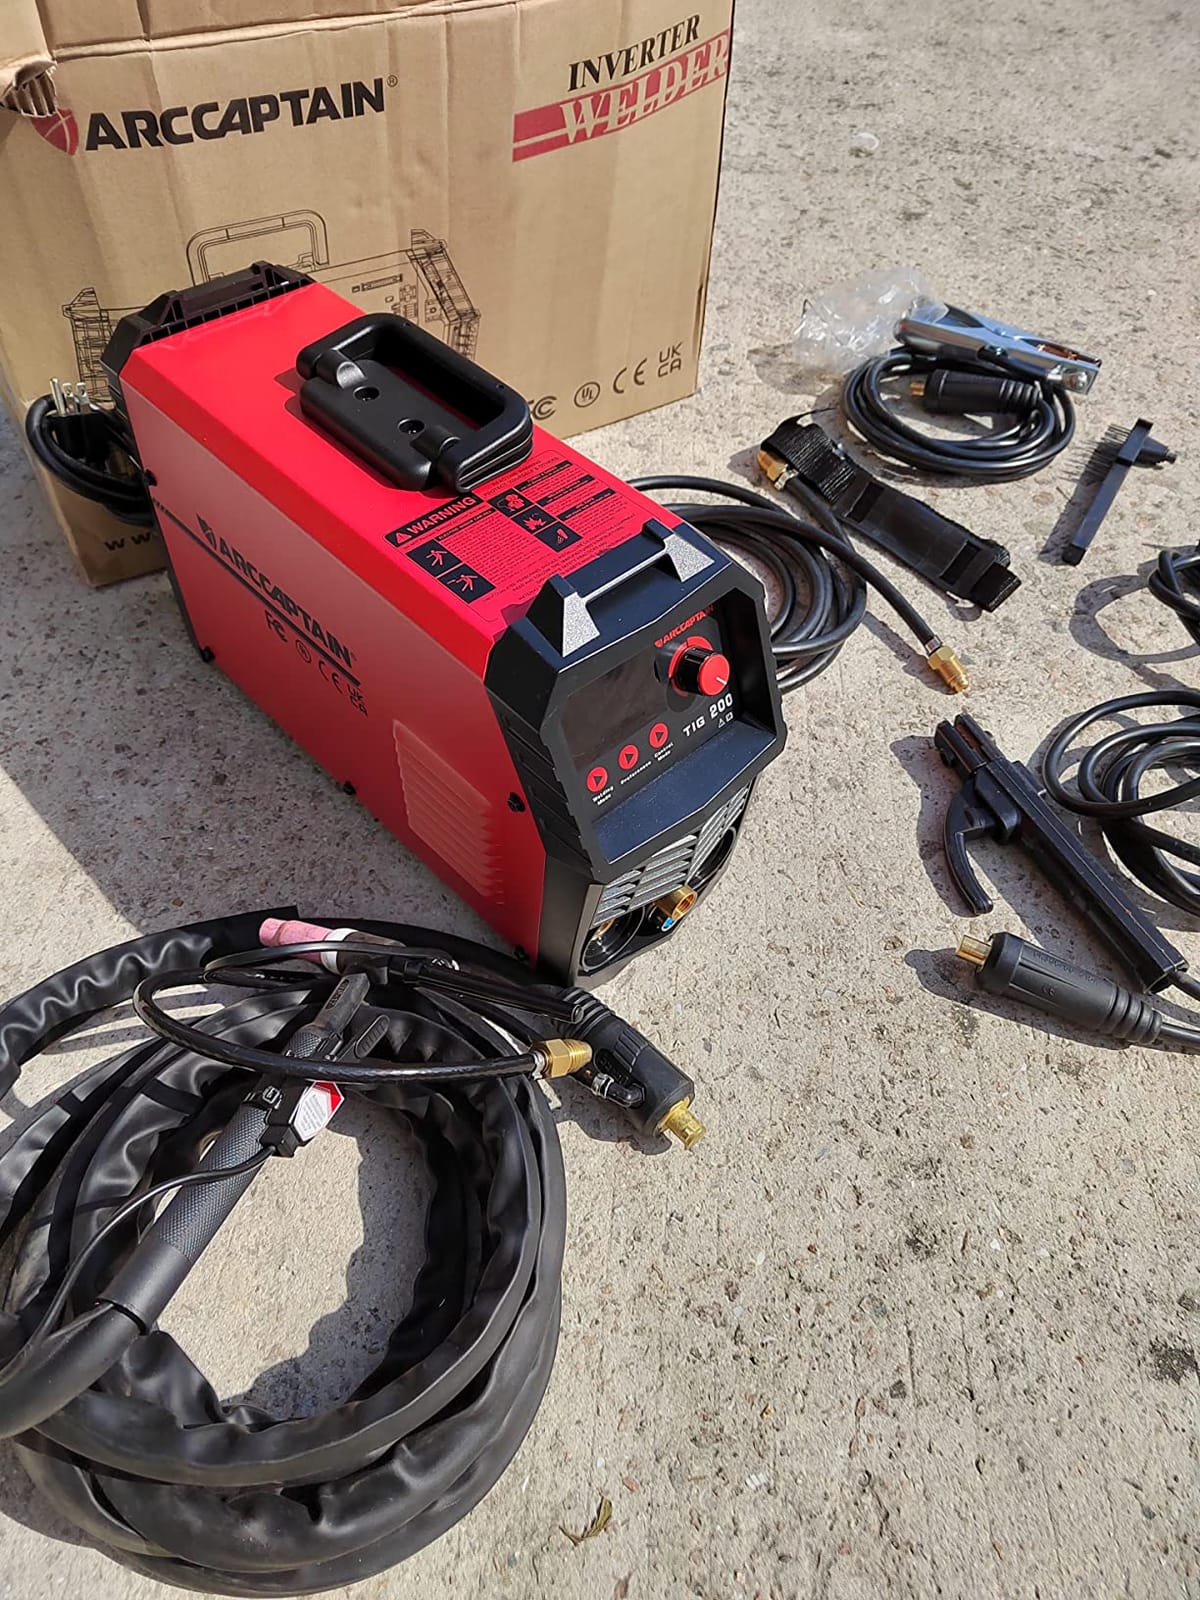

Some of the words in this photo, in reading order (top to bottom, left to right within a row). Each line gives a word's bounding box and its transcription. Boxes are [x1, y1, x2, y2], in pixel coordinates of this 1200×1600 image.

[567, 14, 700, 92] INVERTER
[85, 77, 385, 151] ARCCAPTAIN
[560, 34, 729, 143] WELDER
[657, 358, 682, 378] CA
[658, 342, 682, 363] UK
[406, 496, 477, 534] WARNING
[219, 536, 352, 669] ARCCAPTAIN
[682, 716, 706, 737] TIG
[709, 692, 734, 719] 200
